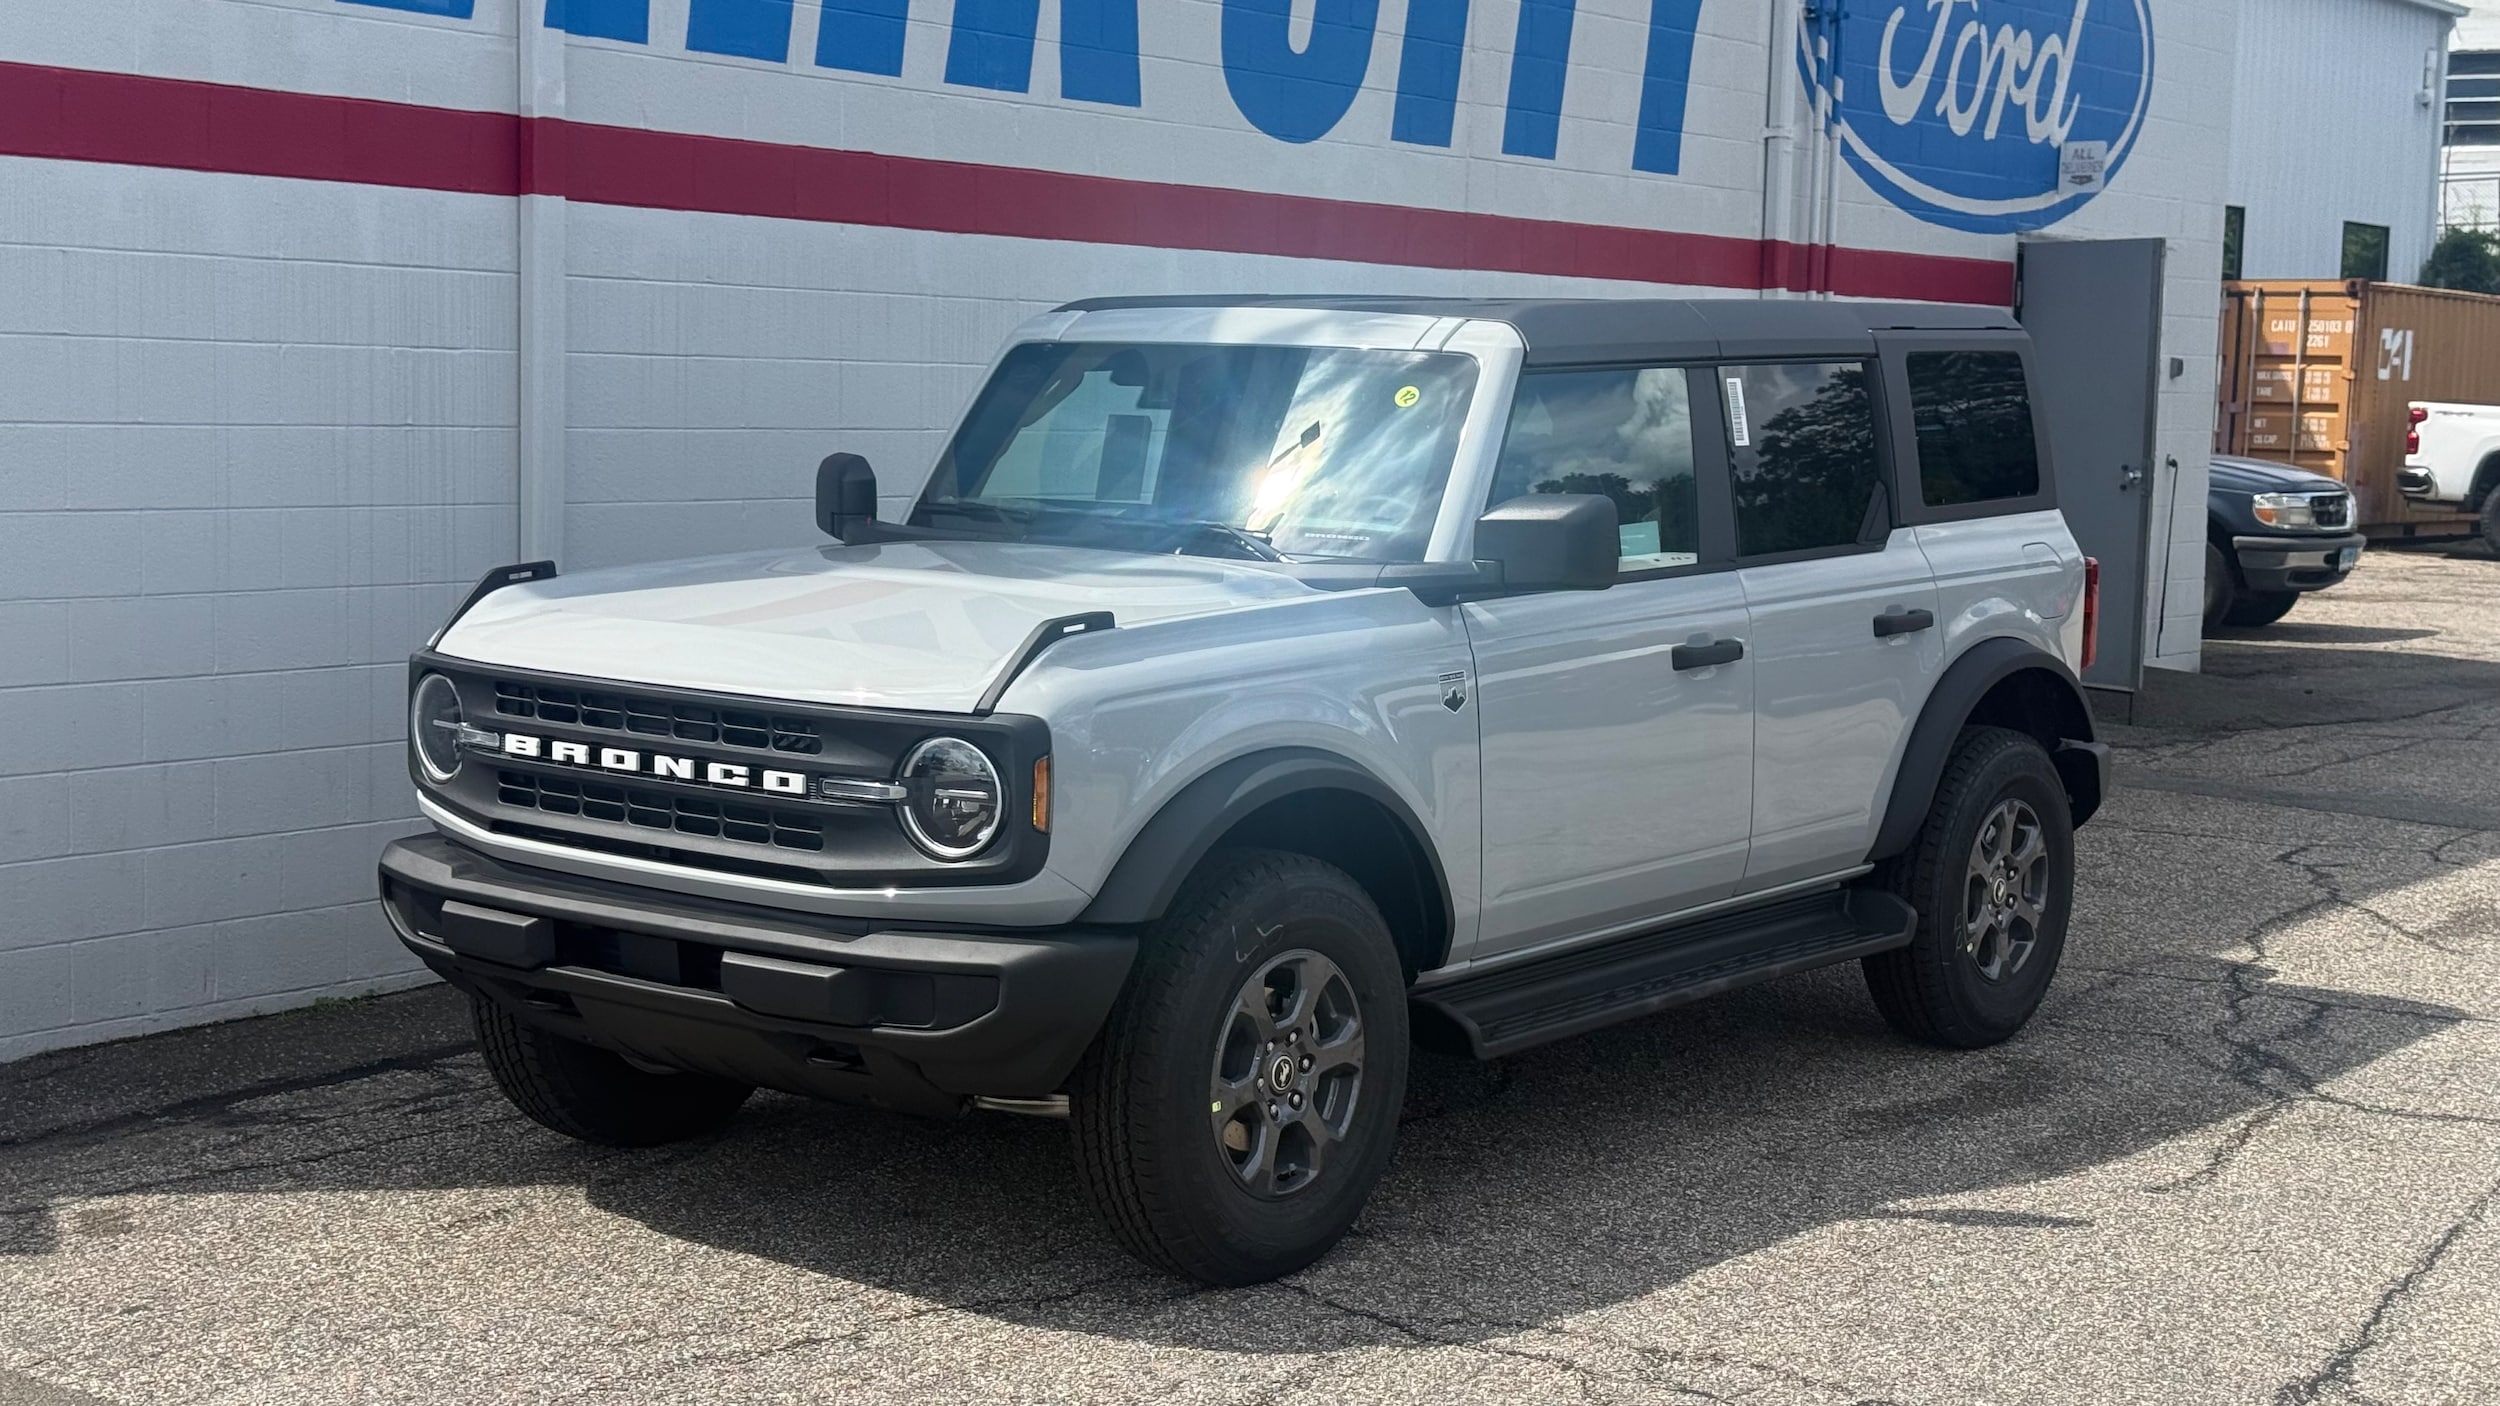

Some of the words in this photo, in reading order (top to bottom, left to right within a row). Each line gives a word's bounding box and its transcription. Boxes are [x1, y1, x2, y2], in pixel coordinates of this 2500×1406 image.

[1879, 0, 2089, 149] Ford
[2072, 148, 2095, 161] ALL
[2271, 320, 2296, 333] CAIU
[504, 732, 806, 796] BRONCO
